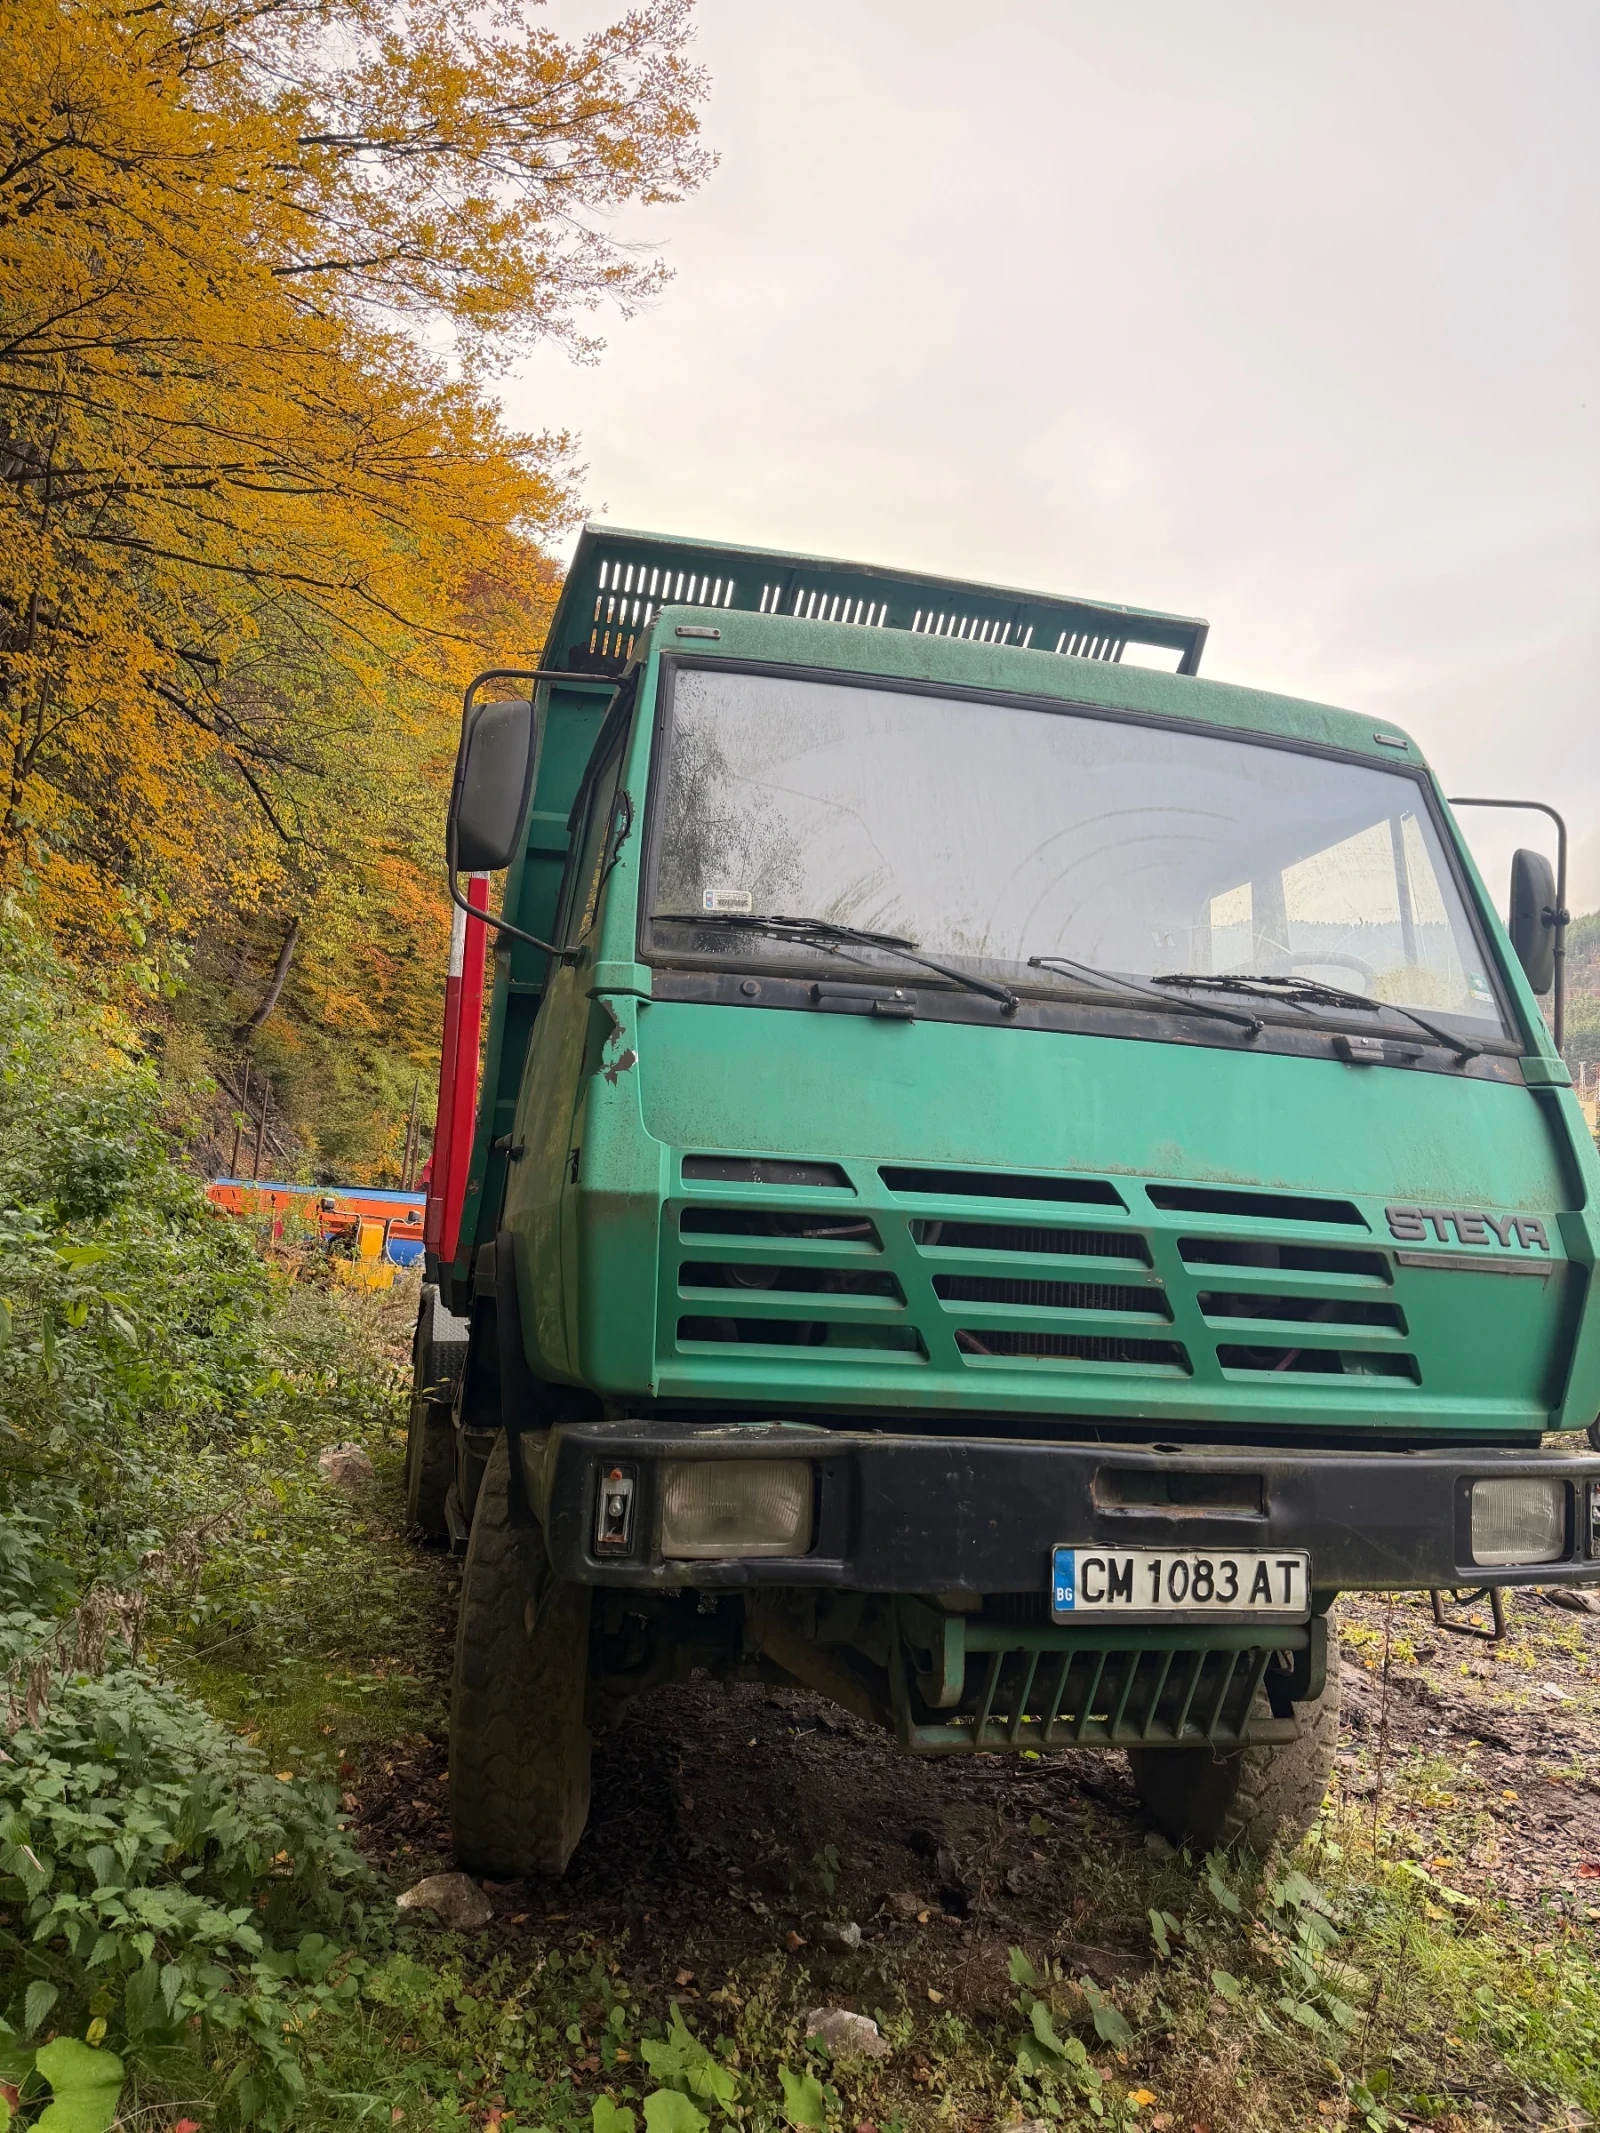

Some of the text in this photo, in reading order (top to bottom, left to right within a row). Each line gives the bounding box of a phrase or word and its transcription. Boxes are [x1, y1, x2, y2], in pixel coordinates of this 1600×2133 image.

[1384, 1205, 1550, 1250] STEYR
[1056, 1587, 1073, 1601] BG
[1081, 1558, 1300, 1603] CM 1083 AT
